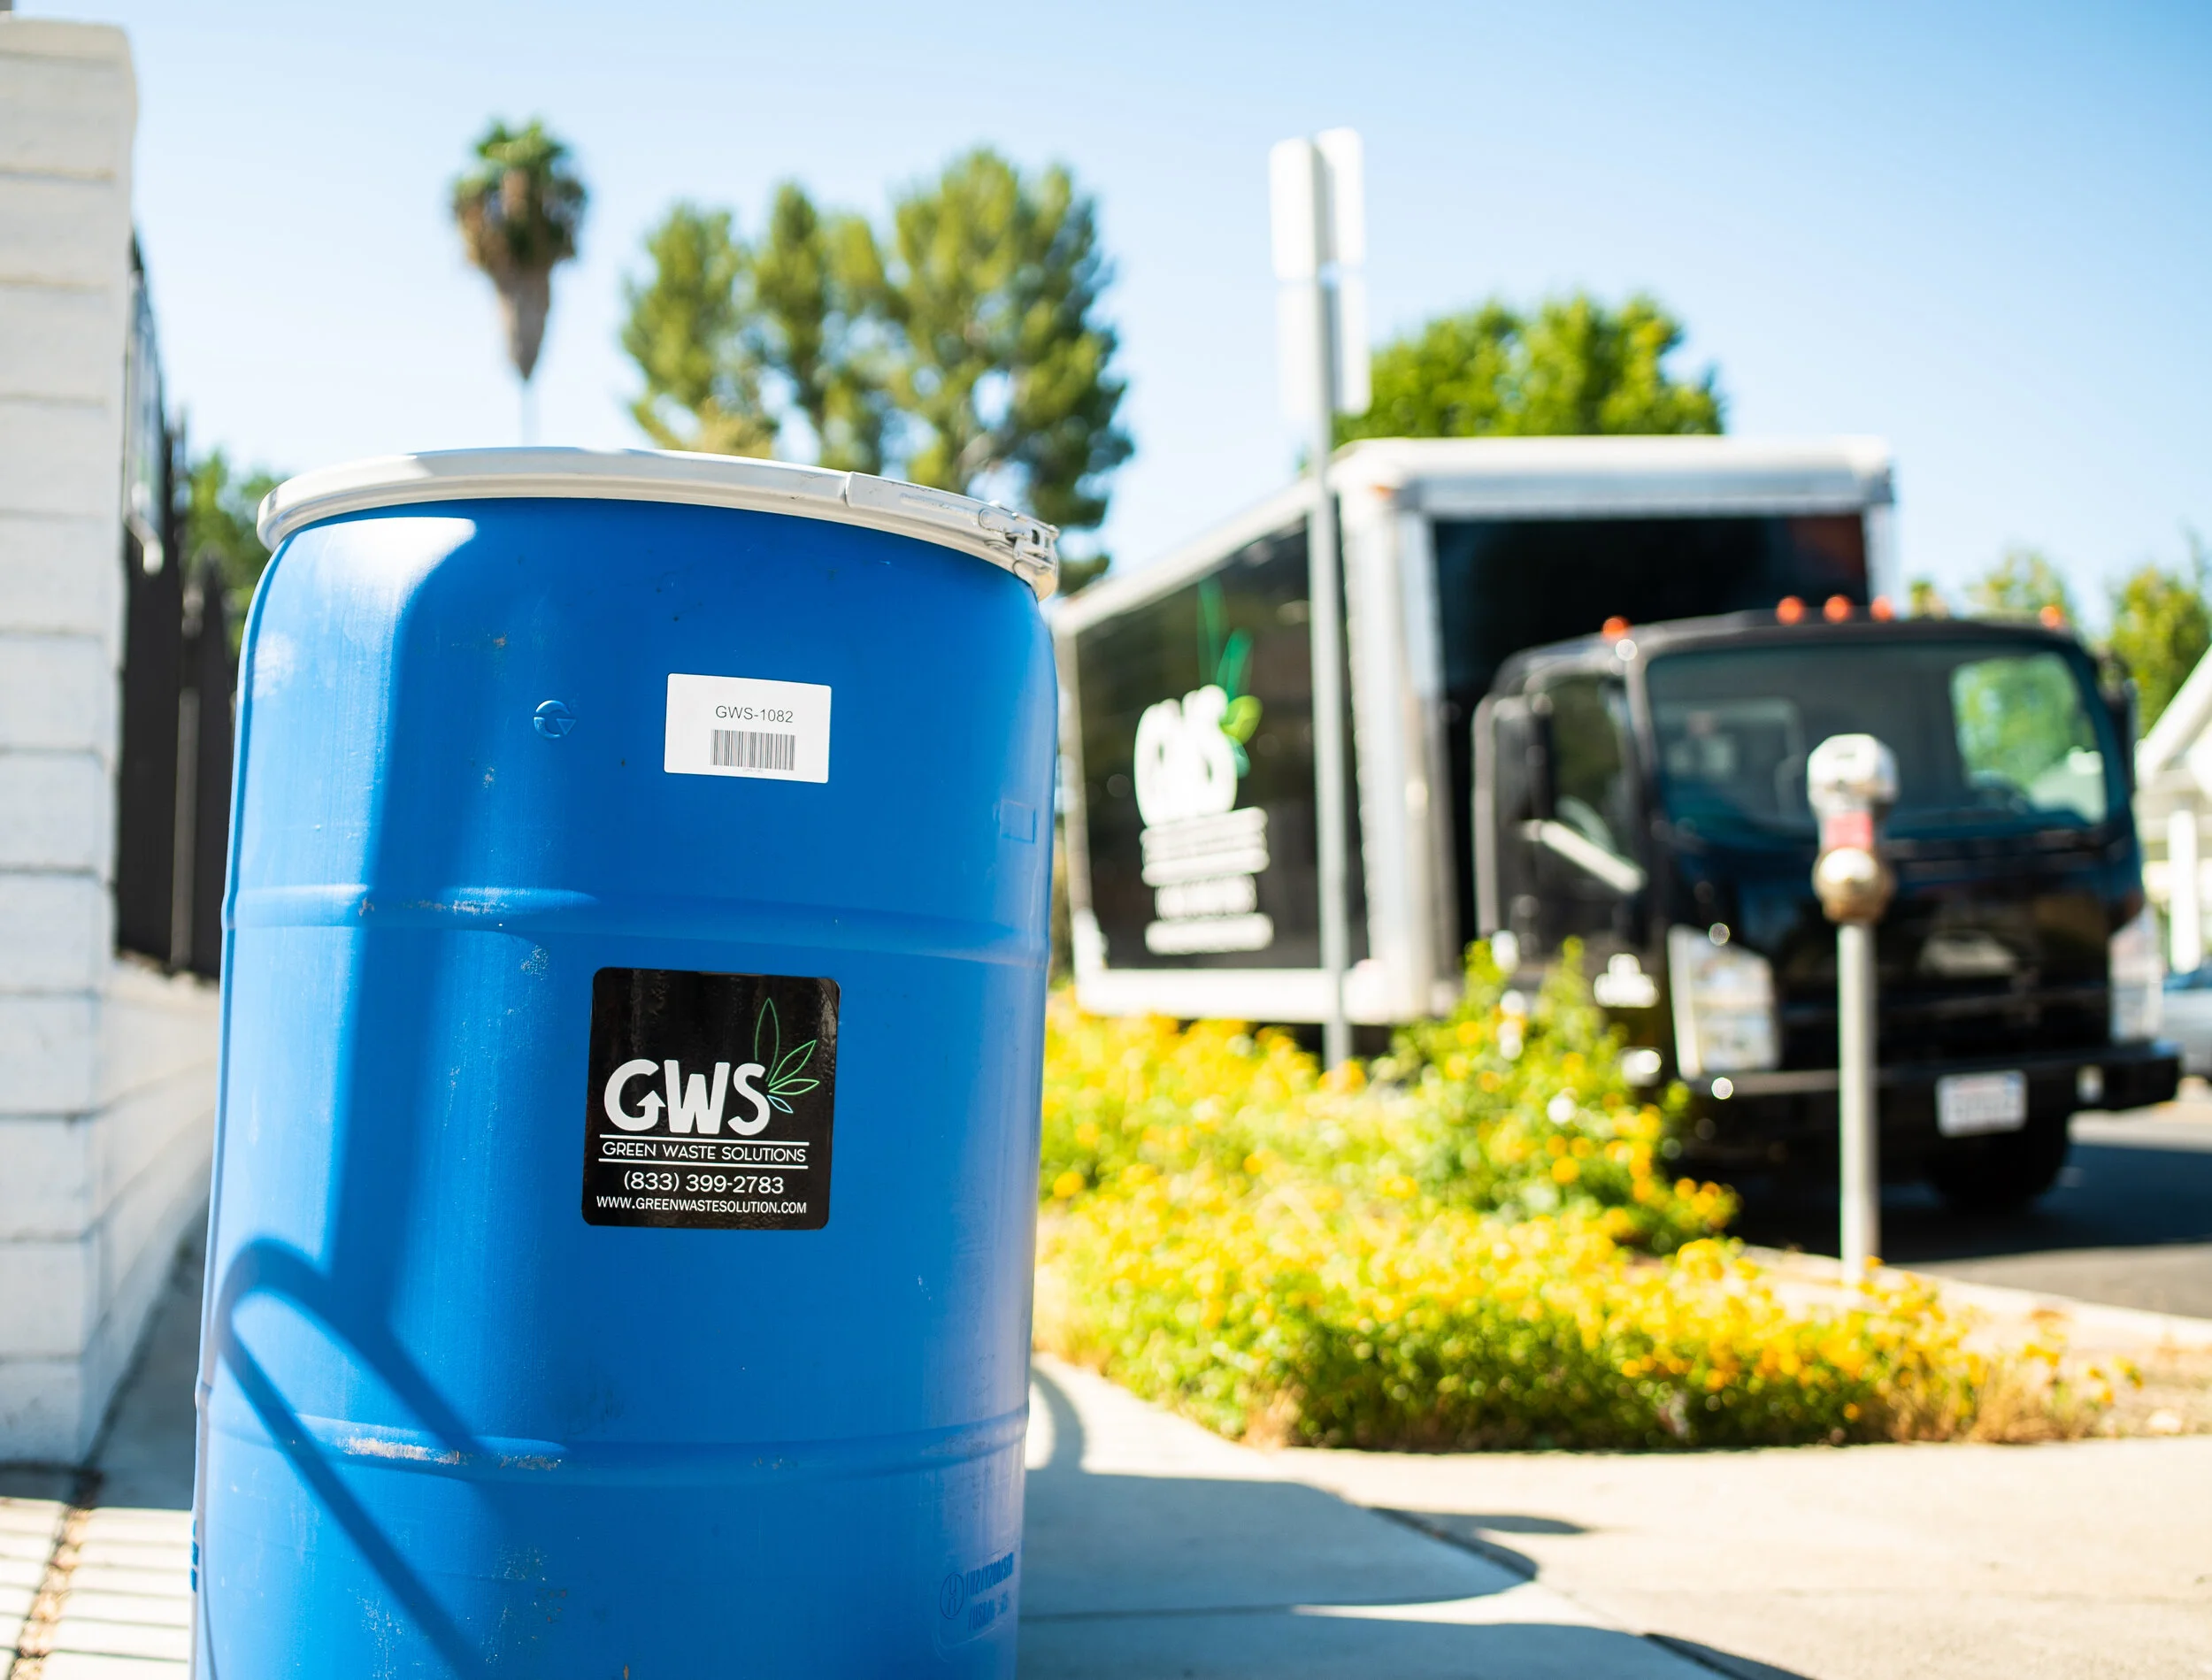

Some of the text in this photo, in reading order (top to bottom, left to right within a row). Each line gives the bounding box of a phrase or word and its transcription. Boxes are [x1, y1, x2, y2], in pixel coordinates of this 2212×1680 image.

[715, 705, 794, 724] GWS-1082
[603, 1059, 771, 1136] GWS
[602, 1141, 806, 1162] GREEN WASTE SOLUTIONS
[624, 1170, 784, 1194] (833) 399-2783
[596, 1195, 808, 1215] WWW.GREENWASTESOLUTION.COM
